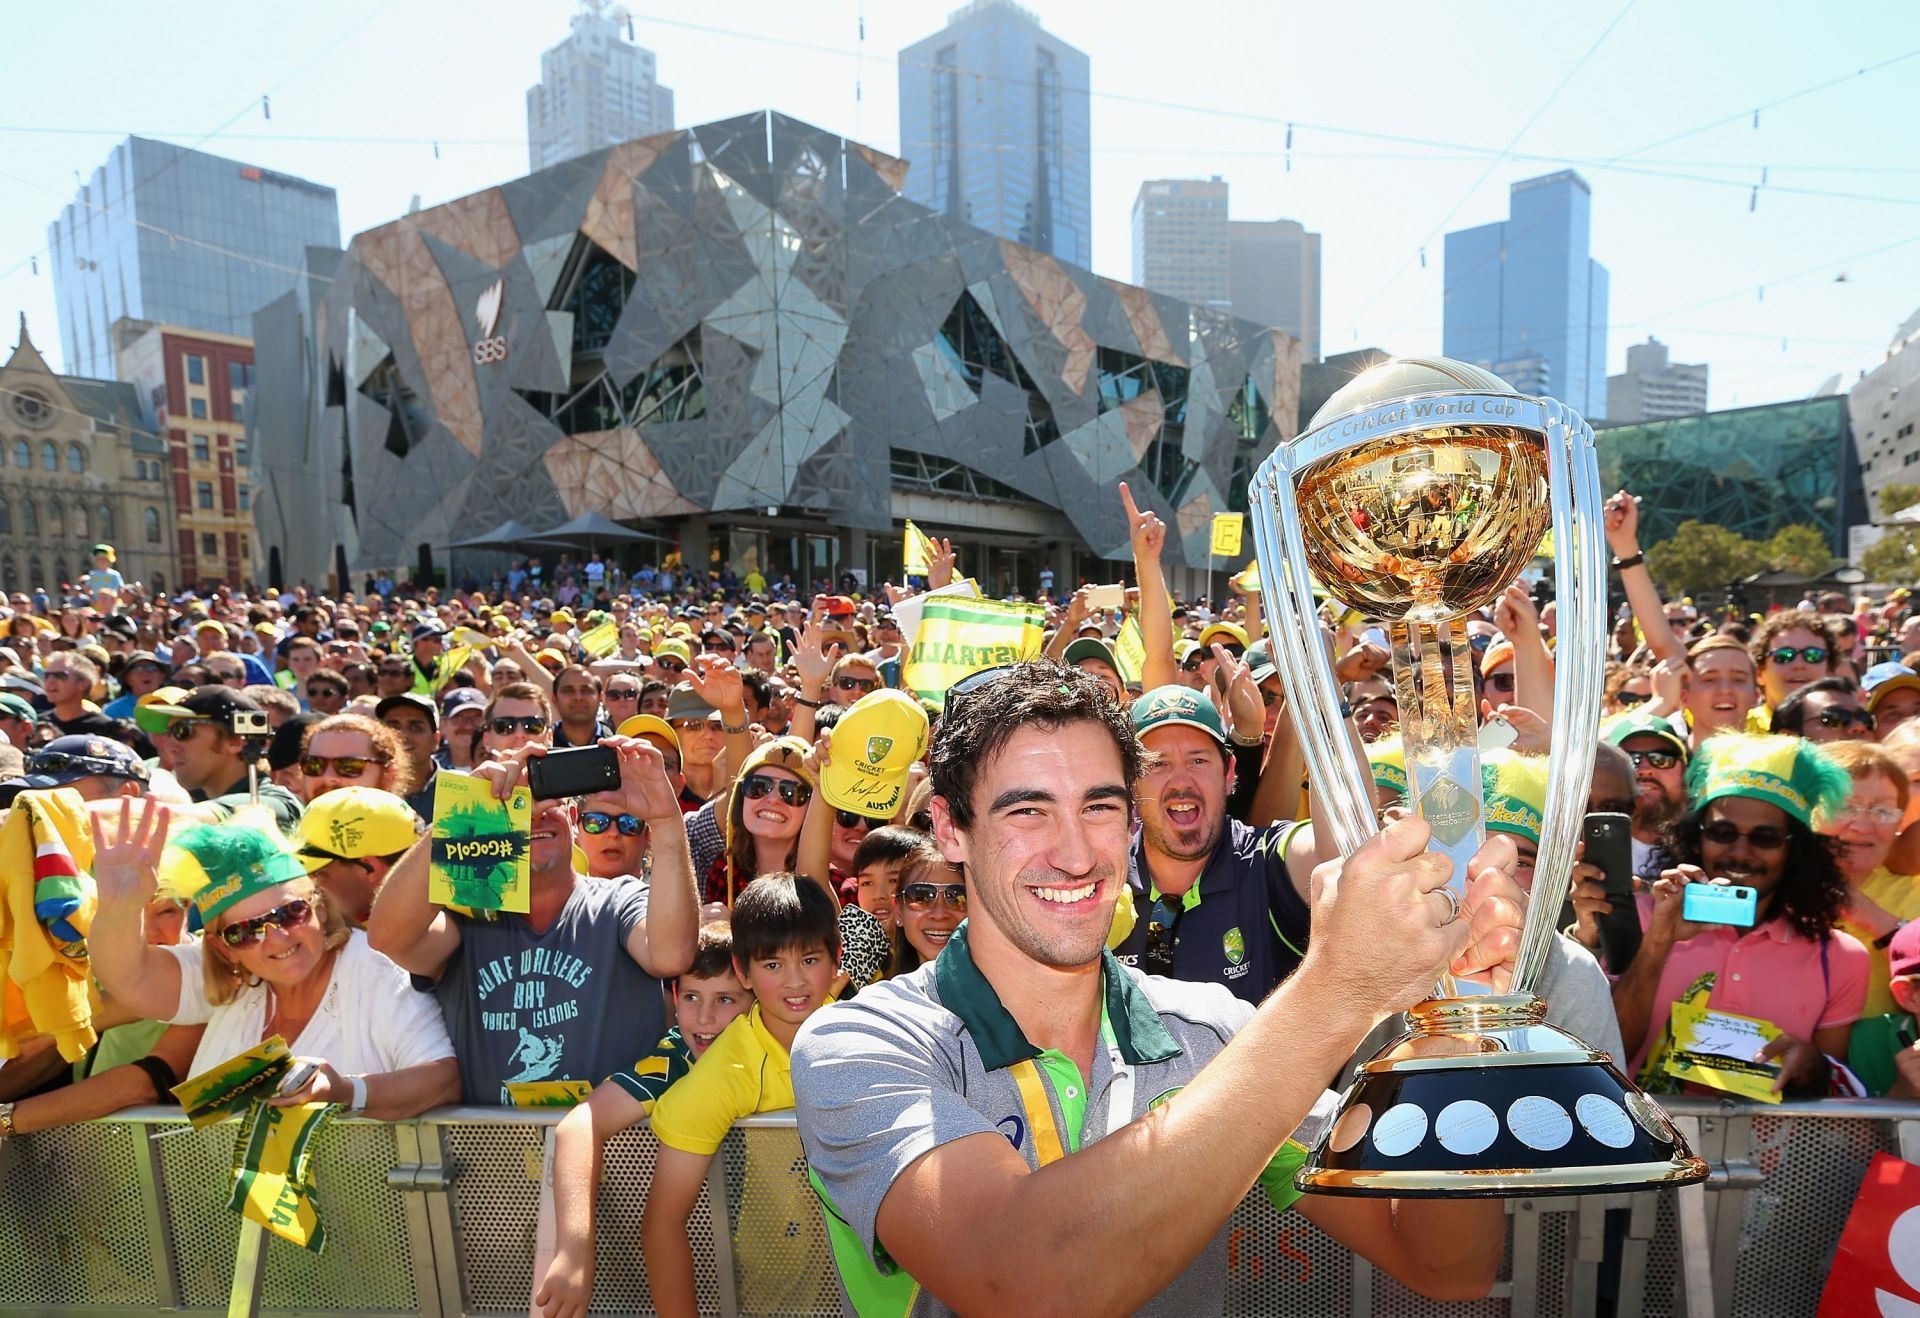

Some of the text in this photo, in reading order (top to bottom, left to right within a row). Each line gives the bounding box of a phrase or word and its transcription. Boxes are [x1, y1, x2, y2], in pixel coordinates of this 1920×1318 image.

[1313, 399, 1516, 451] ICC Cricket World Cup
[854, 759, 885, 773] CRICKET
[866, 784, 901, 811] AUSTRALIA
[445, 839, 513, 861] #GoGold
[520, 947, 593, 989] WALKERS
[1113, 954, 1139, 966] SICS
[1223, 960, 1251, 976] CRICKET
[513, 980, 546, 1010] BAY
[533, 999, 579, 1029] ISLANDS
